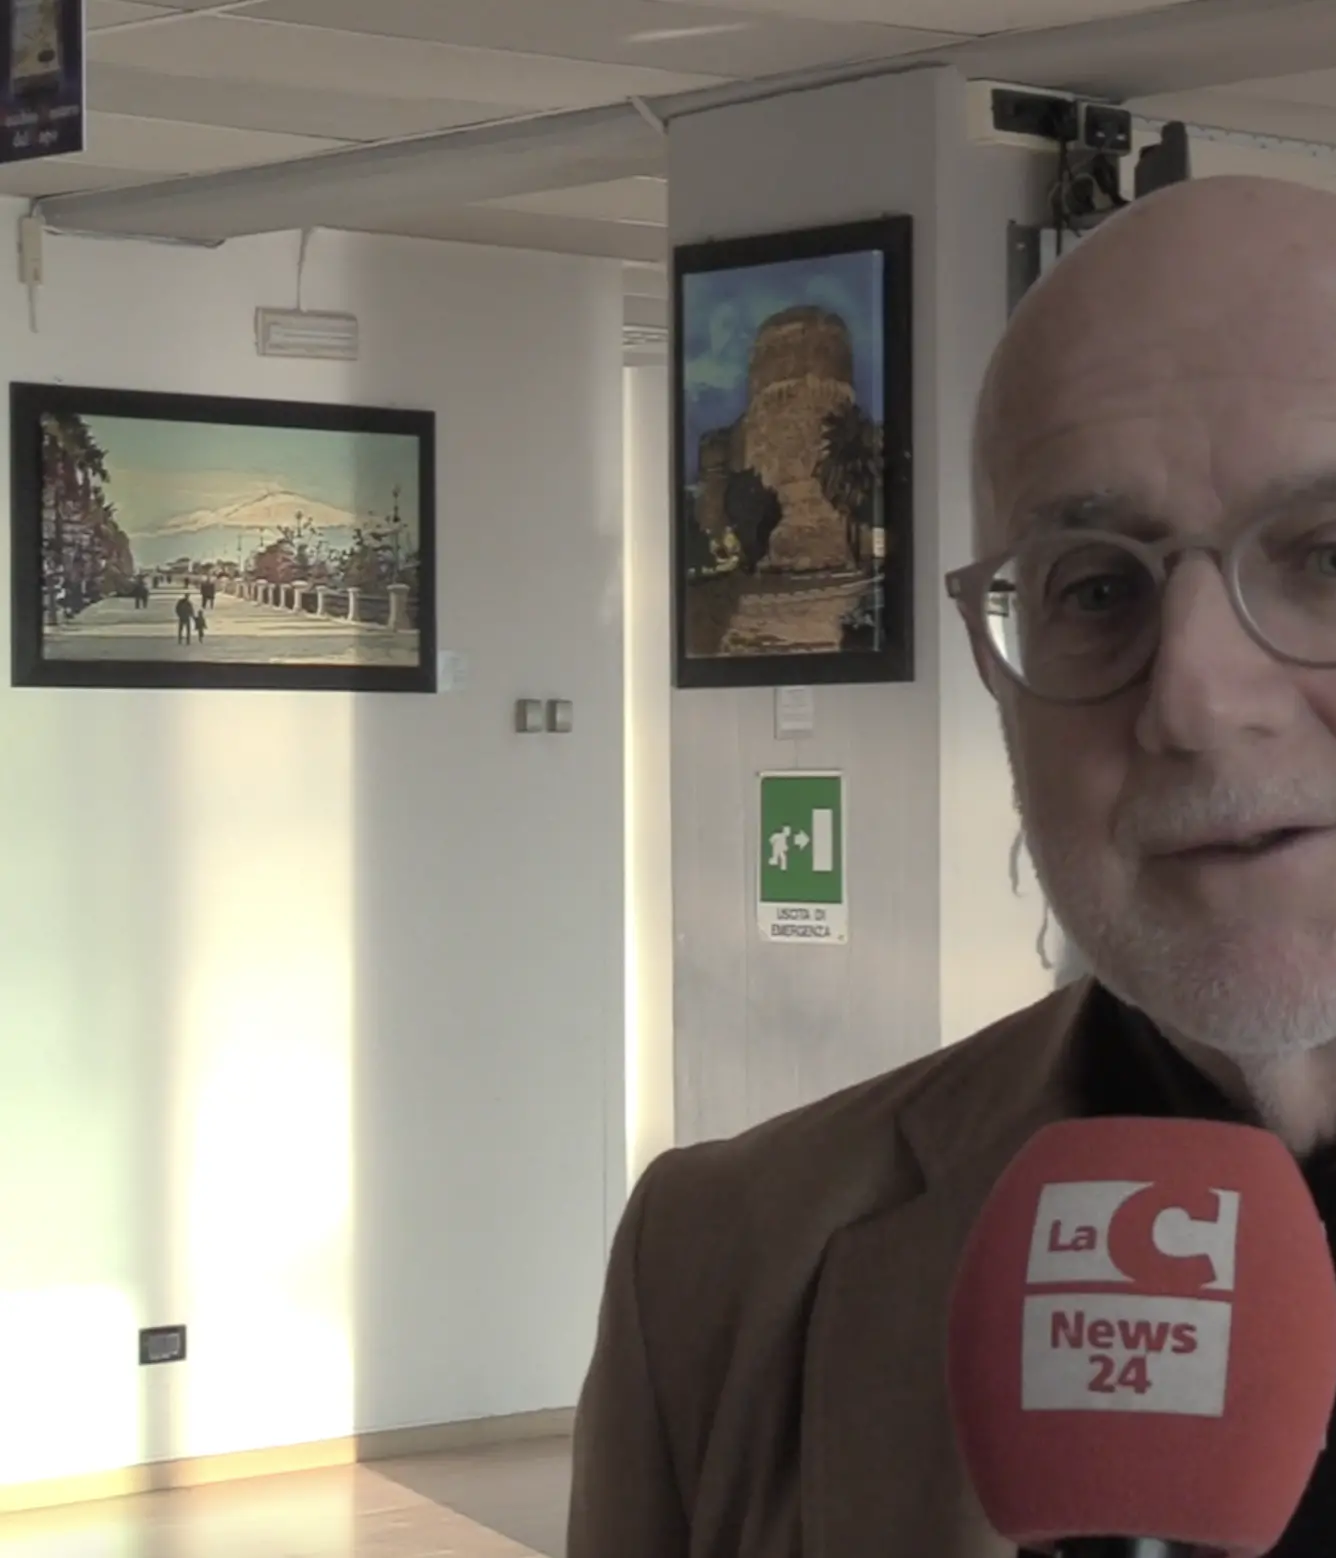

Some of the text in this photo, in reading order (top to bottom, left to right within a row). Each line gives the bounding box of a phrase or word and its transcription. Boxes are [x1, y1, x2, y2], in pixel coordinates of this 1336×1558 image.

[771, 923, 831, 937] EMERGENZA
[776, 908, 827, 921] USCITA DI
[1047, 1181, 1219, 1295] La C
[1050, 1310, 1198, 1354] News
[1087, 1354, 1153, 1394] 24
